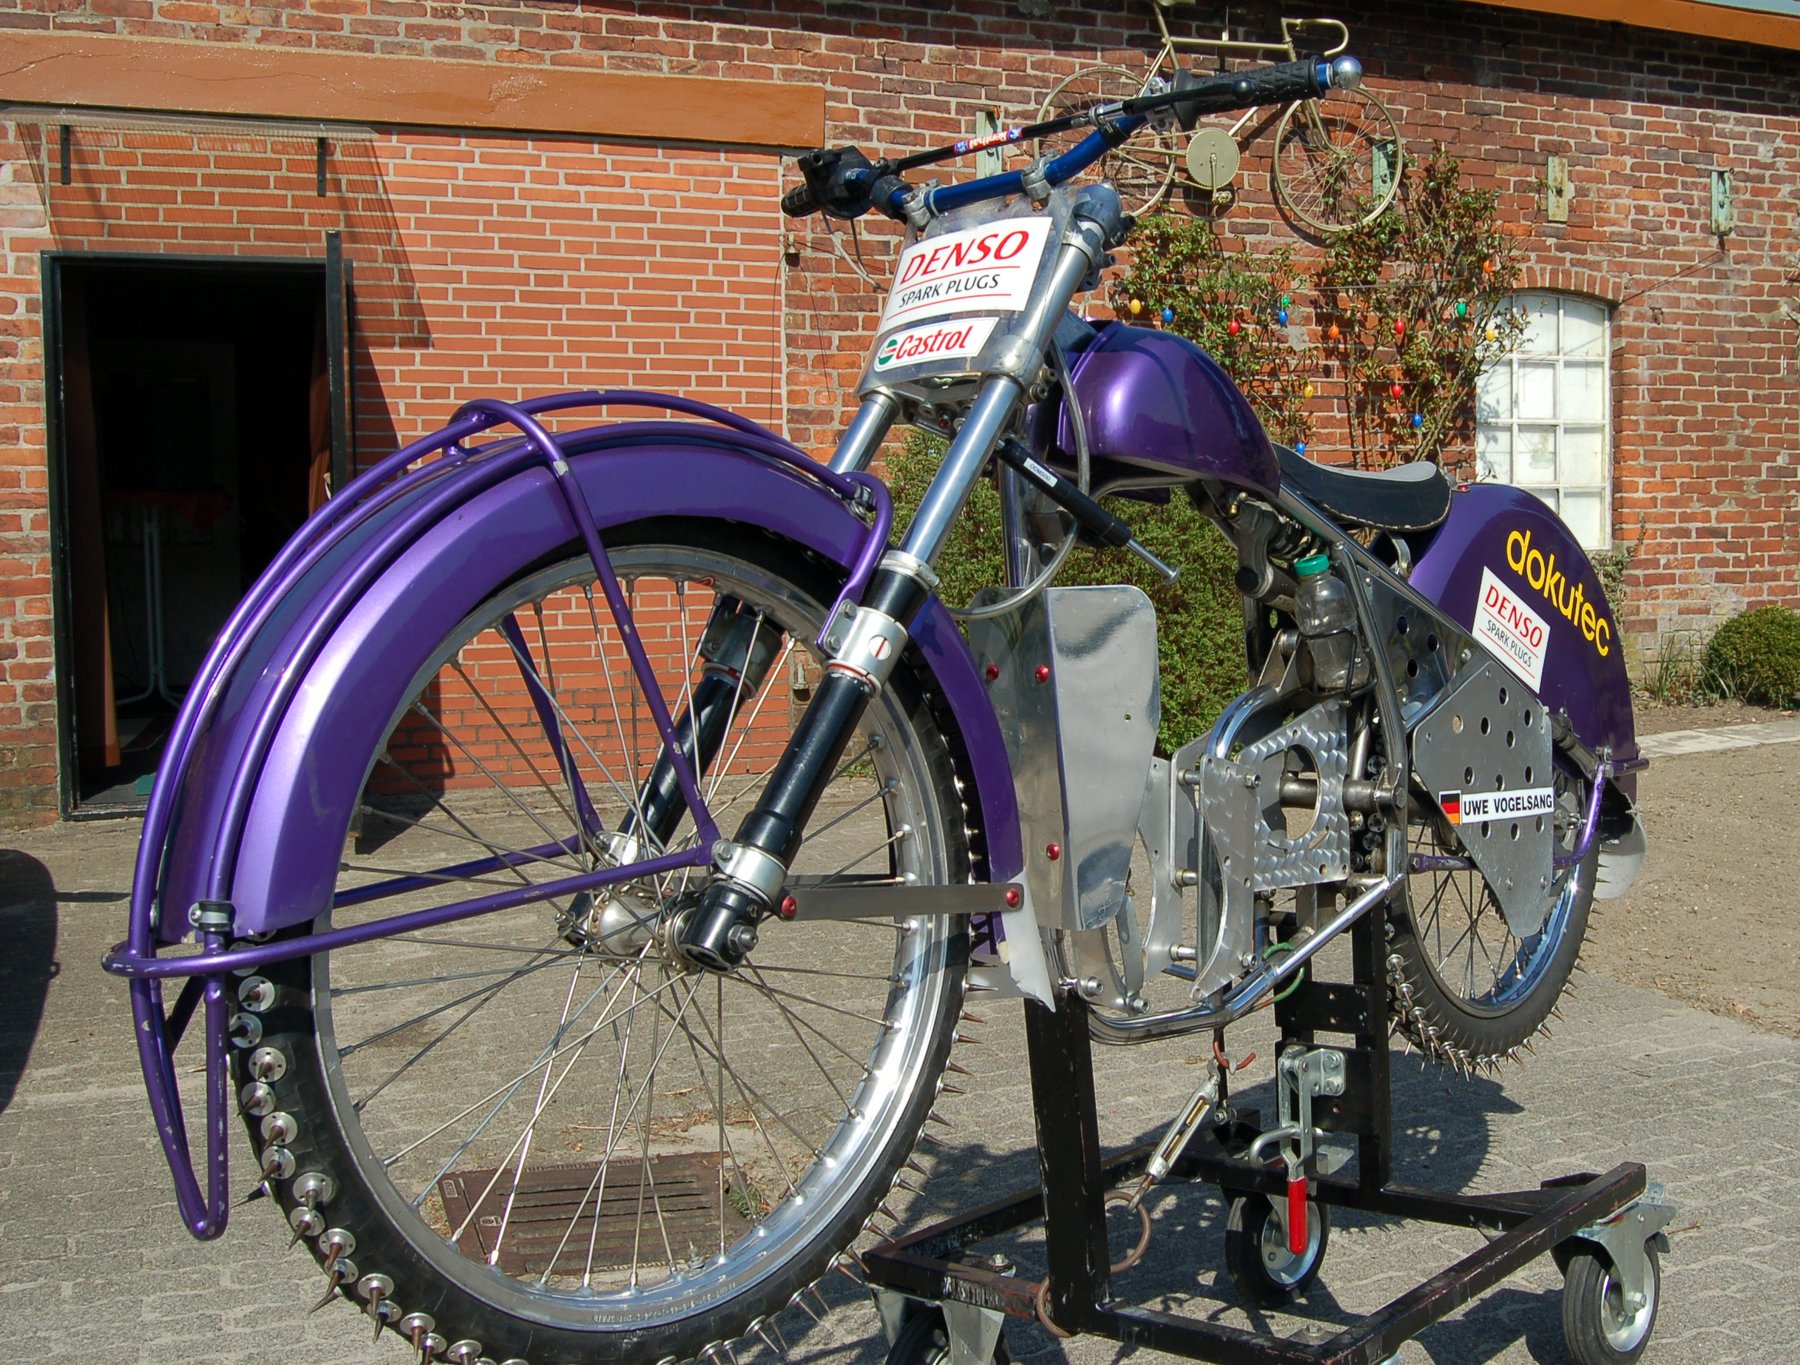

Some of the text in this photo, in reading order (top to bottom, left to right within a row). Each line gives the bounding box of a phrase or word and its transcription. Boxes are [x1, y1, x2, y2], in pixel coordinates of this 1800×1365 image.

[899, 230, 1030, 285] DENSO
[898, 273, 1001, 308] SPARK PLUGS
[895, 325, 974, 360] Castrol
[1484, 583, 1543, 649] DENSO
[1506, 529, 1610, 658] dokutec
[1487, 619, 1533, 668] SPARK PLUGS
[1463, 793, 1553, 817] UWE VOGELSANG
